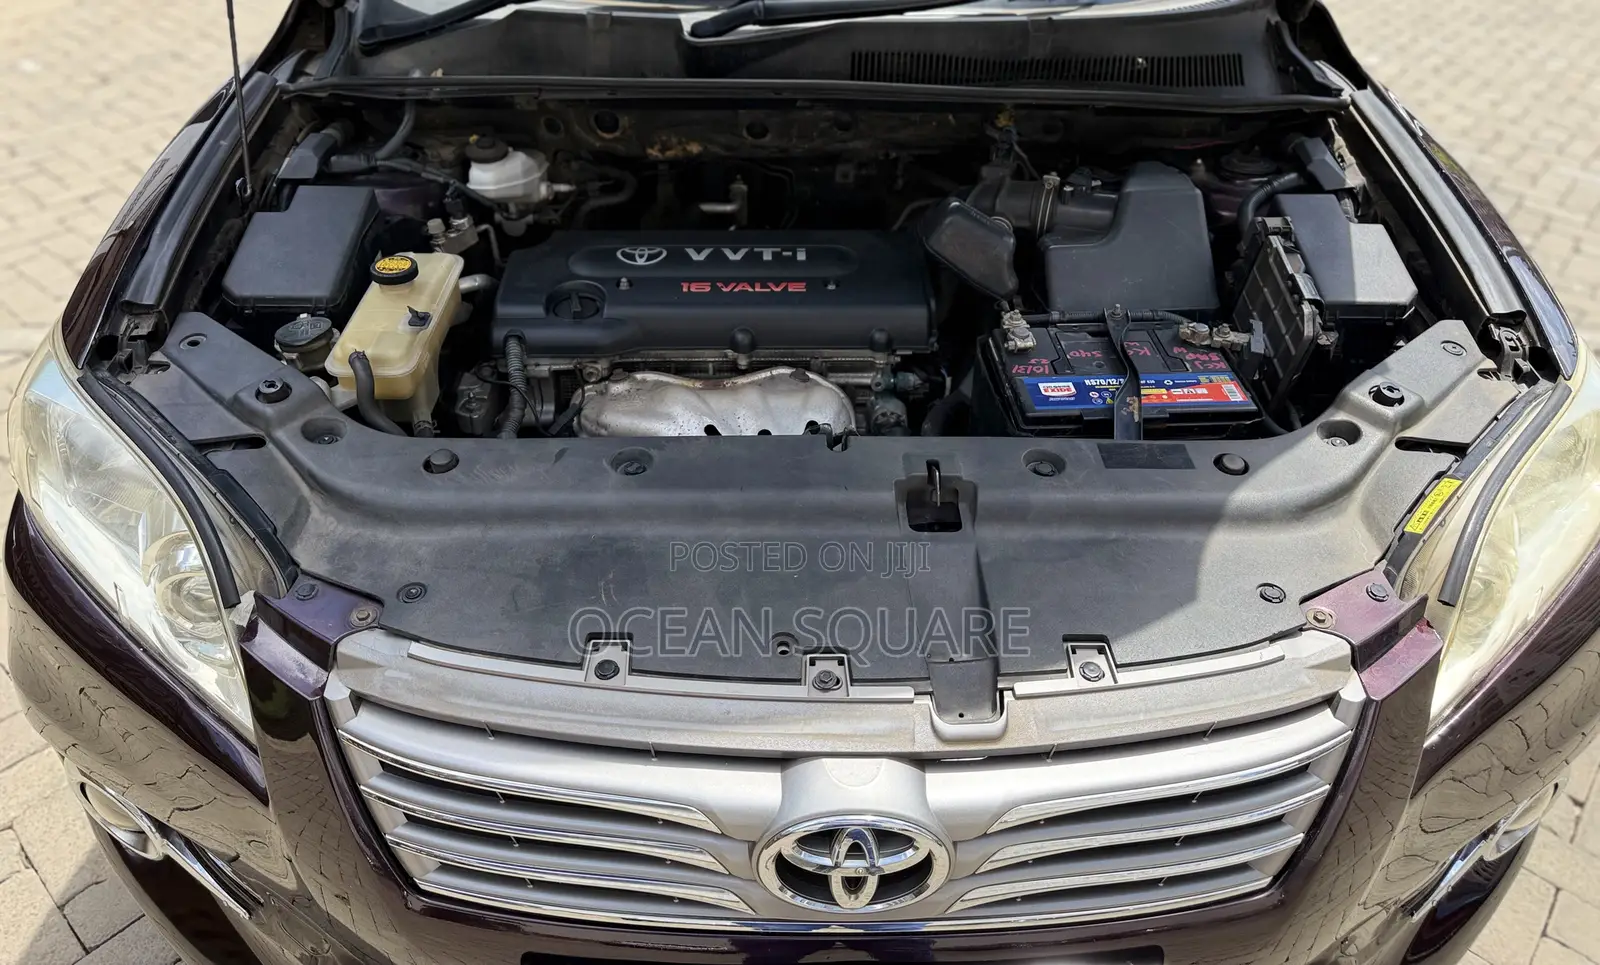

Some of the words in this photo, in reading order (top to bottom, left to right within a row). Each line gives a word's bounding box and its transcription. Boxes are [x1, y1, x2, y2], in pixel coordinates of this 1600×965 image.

[684, 247, 807, 261] VVT-i
[681, 282, 711, 292] 16
[716, 282, 807, 292] VALVE
